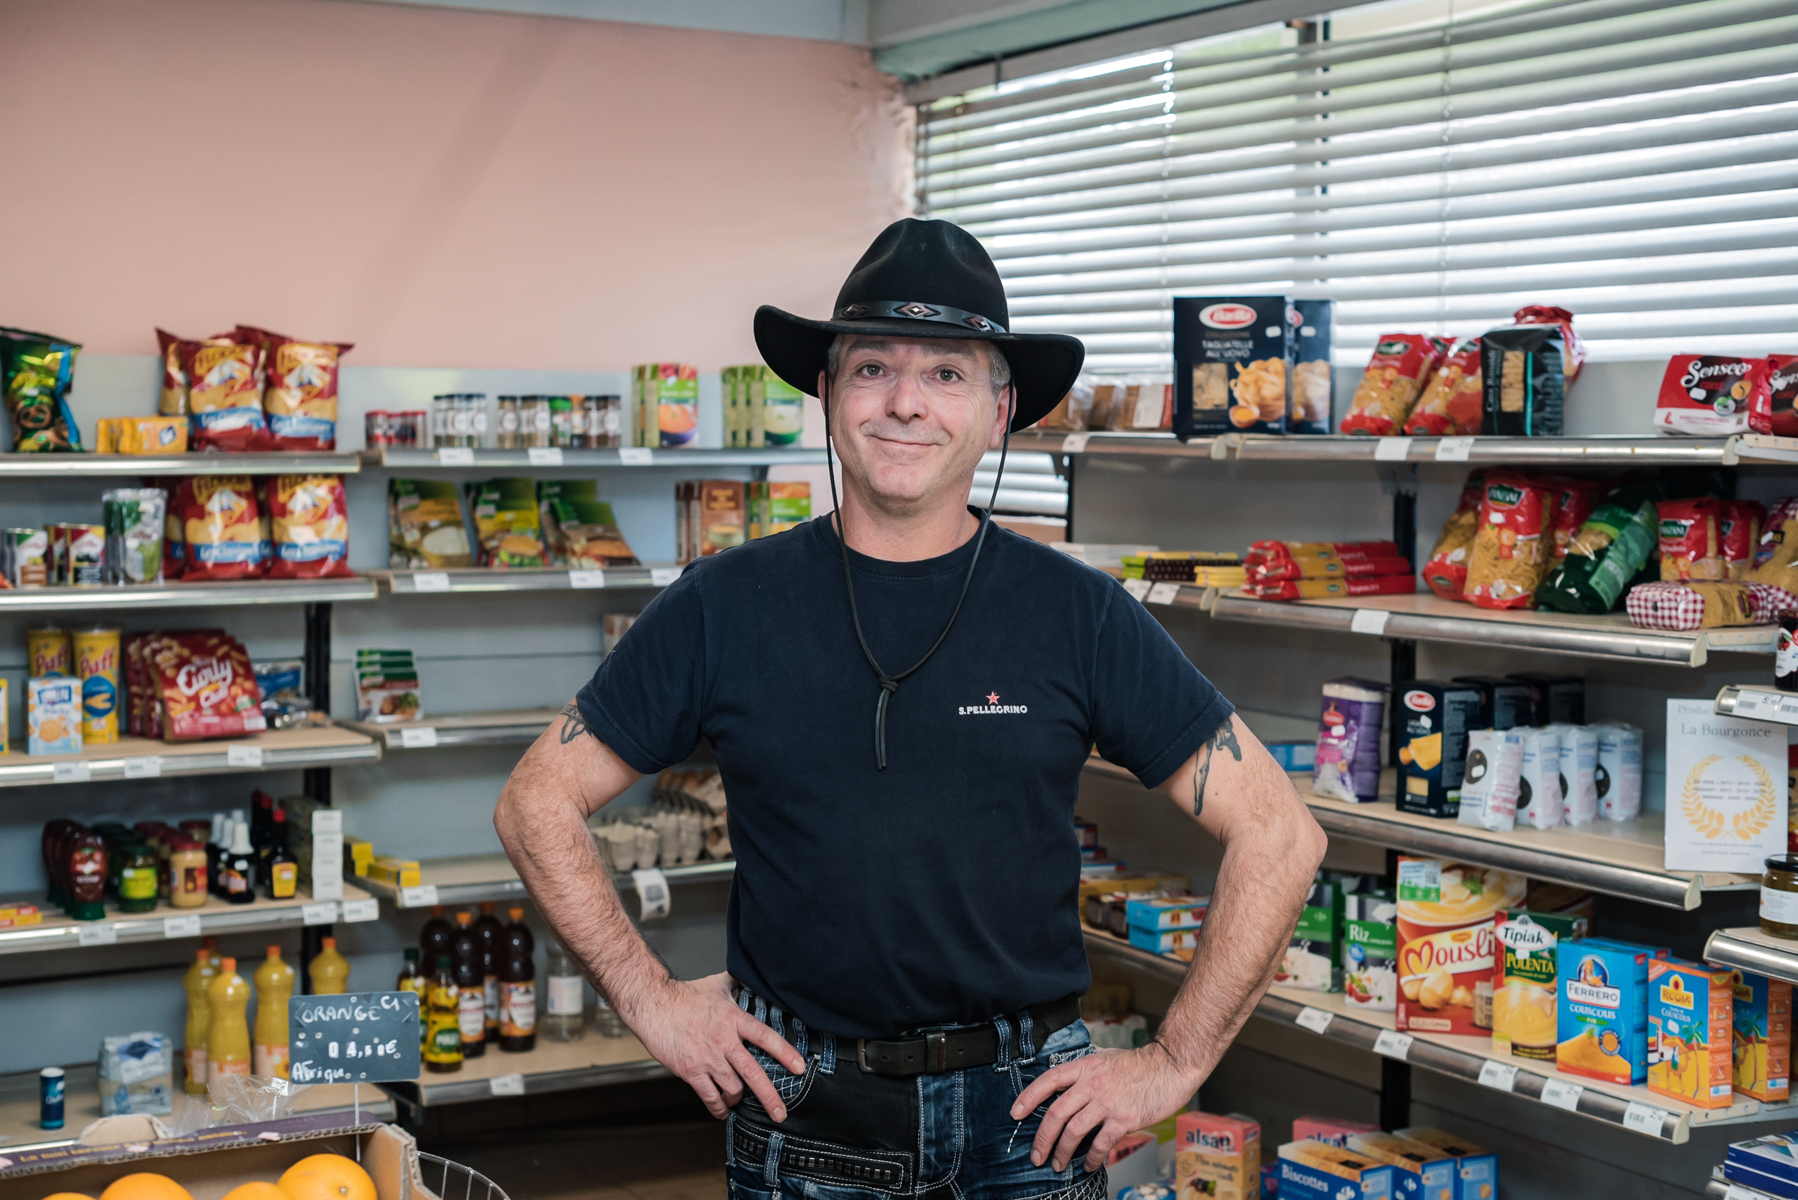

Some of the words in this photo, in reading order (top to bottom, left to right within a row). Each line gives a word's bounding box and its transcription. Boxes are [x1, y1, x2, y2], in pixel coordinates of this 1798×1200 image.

[177, 657, 233, 697] Curly
[958, 705, 1028, 716] S.PELLEGRINO
[1678, 704, 1716, 715] Produc
[1681, 723, 1697, 735] La
[1702, 724, 1772, 738] Bourgonce
[1349, 924, 1370, 943] Riz
[1503, 926, 1544, 945] Tipiak
[1404, 928, 1496, 976] Mousli
[1506, 952, 1555, 974] POLENTA
[1568, 982, 1619, 1003] FERRERO
[301, 1004, 382, 1024] ORANGE
[1569, 1003, 1616, 1020] COUSCOUS
[1281, 1163, 1329, 1193] Biscottes
